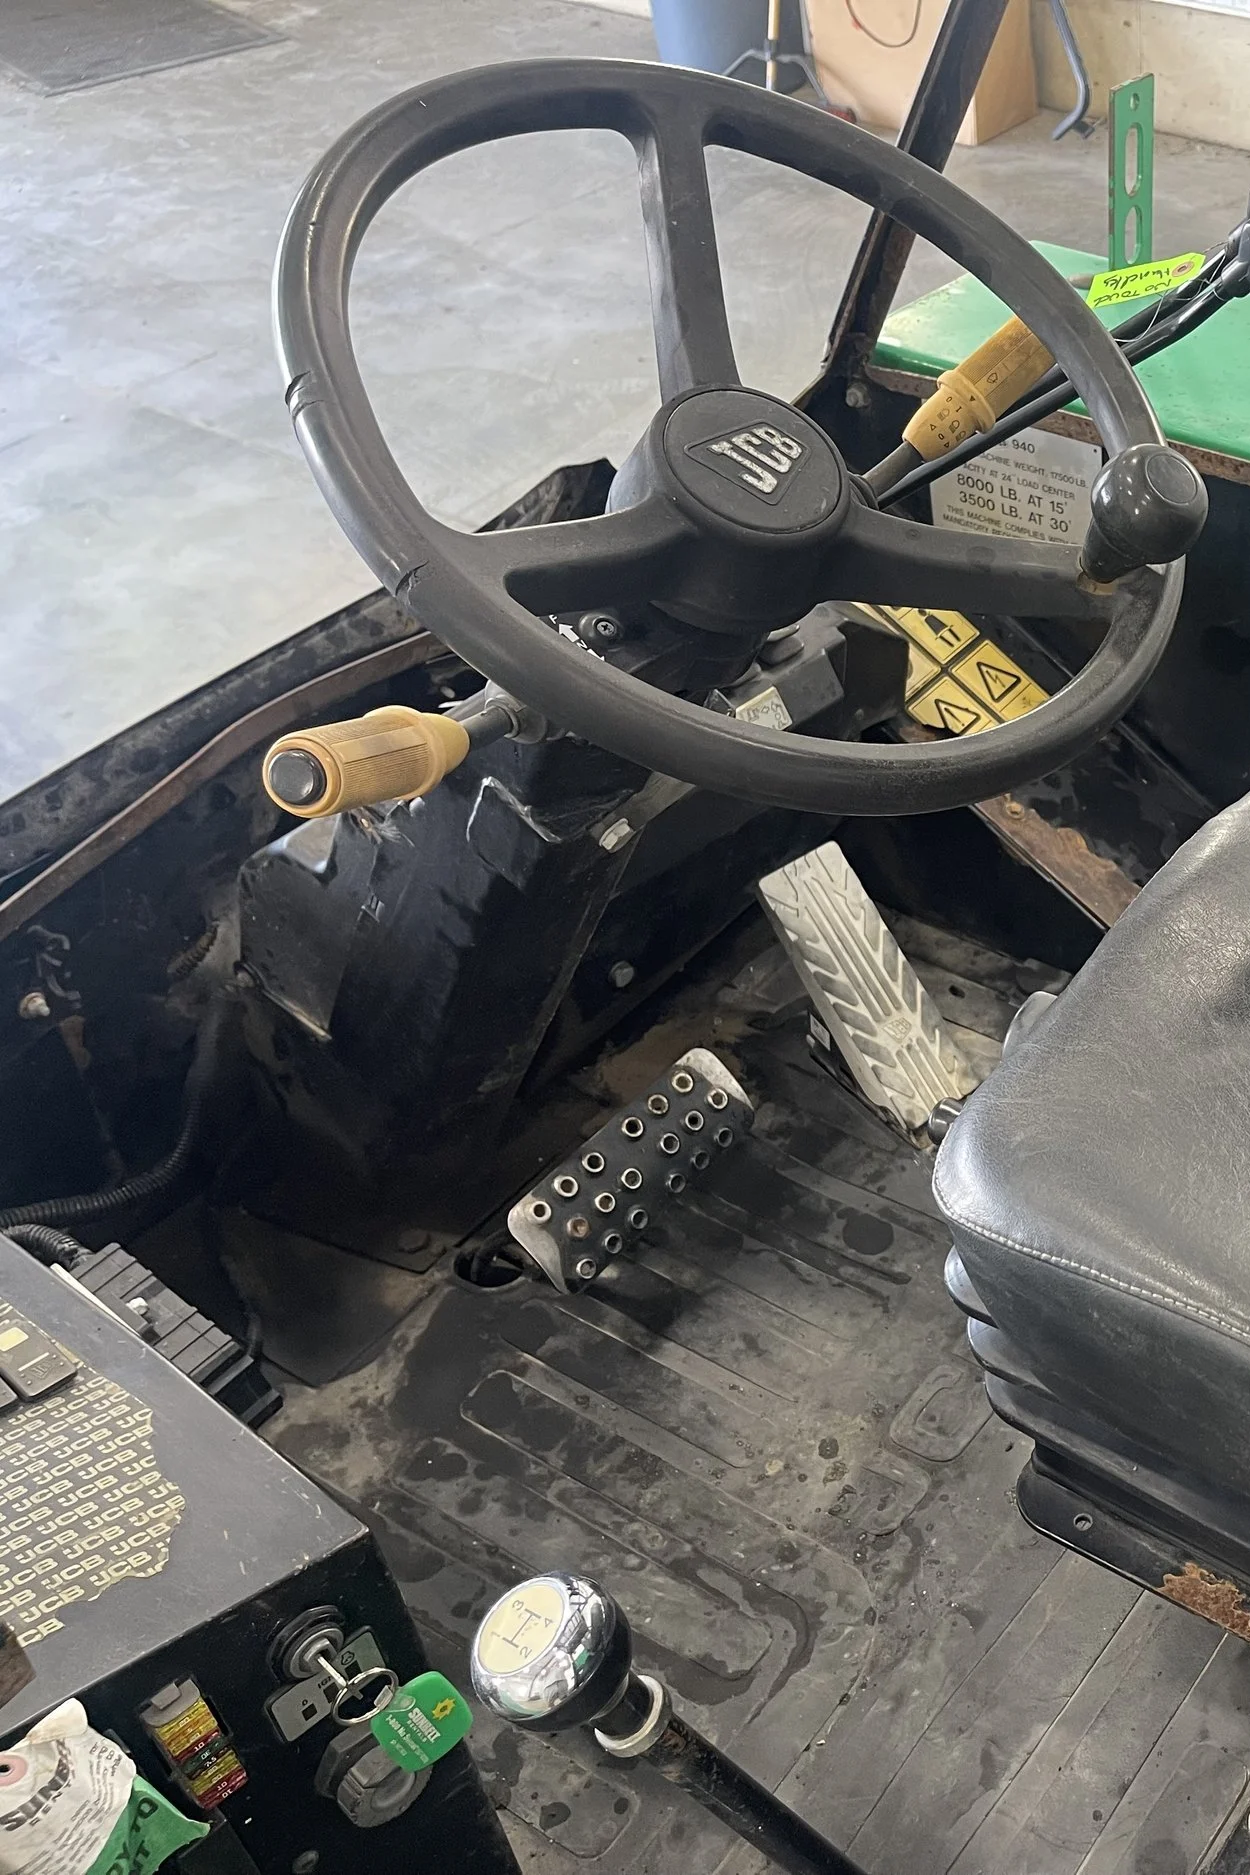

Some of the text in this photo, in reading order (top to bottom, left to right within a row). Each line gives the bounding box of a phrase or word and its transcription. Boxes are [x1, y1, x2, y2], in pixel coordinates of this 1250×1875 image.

[706, 427, 802, 494] JCB
[980, 452, 1011, 467] ACHINE
[1012, 439, 1036, 454] 940
[956, 473, 995, 494] 8000
[1000, 485, 1022, 503] LB.
[1028, 493, 1044, 509] AT
[963, 463, 986, 475] ACITY
[1017, 477, 1040, 490] LOAD
[1041, 484, 1076, 501] CENTER
[942, 513, 989, 533] MANDATORY
[946, 504, 965, 517] THIS
[967, 511, 1002, 528] MACHINE
[1005, 522, 1046, 541] COMPLIES
[959, 490, 996, 511] 3500
[1001, 503, 1023, 520] LB.
[1028, 511, 1045, 526] AT
[548, 614, 558, 625] F
[8, 1396, 66, 1425] JCB
[50, 1389, 107, 1418] JCB
[9, 1434, 69, 1466] JCB
[72, 1404, 131, 1434] JCB
[30, 1411, 88, 1441] JCB
[53, 1427, 113, 1458] JCB
[11, 1479, 74, 1512] JCB
[78, 1449, 138, 1480] JCB
[32, 1453, 94, 1485] JCB
[36, 1501, 99, 1535] JCB
[102, 1470, 161, 1502] JCB
[57, 1475, 119, 1507] JCB
[15, 1529, 79, 1564] JCB
[82, 1497, 144, 1530] JCB
[62, 1525, 126, 1559] JCB
[41, 1554, 106, 1590] JCB
[109, 1522, 171, 1556] JCB
[89, 1551, 153, 1587] JCB
[18, 1585, 85, 1623] JCB
[512, 1599, 525, 1611] 3
[17, 1617, 66, 1648] CB
[544, 1617, 554, 1629] 4
[519, 1646, 533, 1660] 2
[194, 1741, 206, 1753] 10
[217, 1781, 229, 1792] 10
